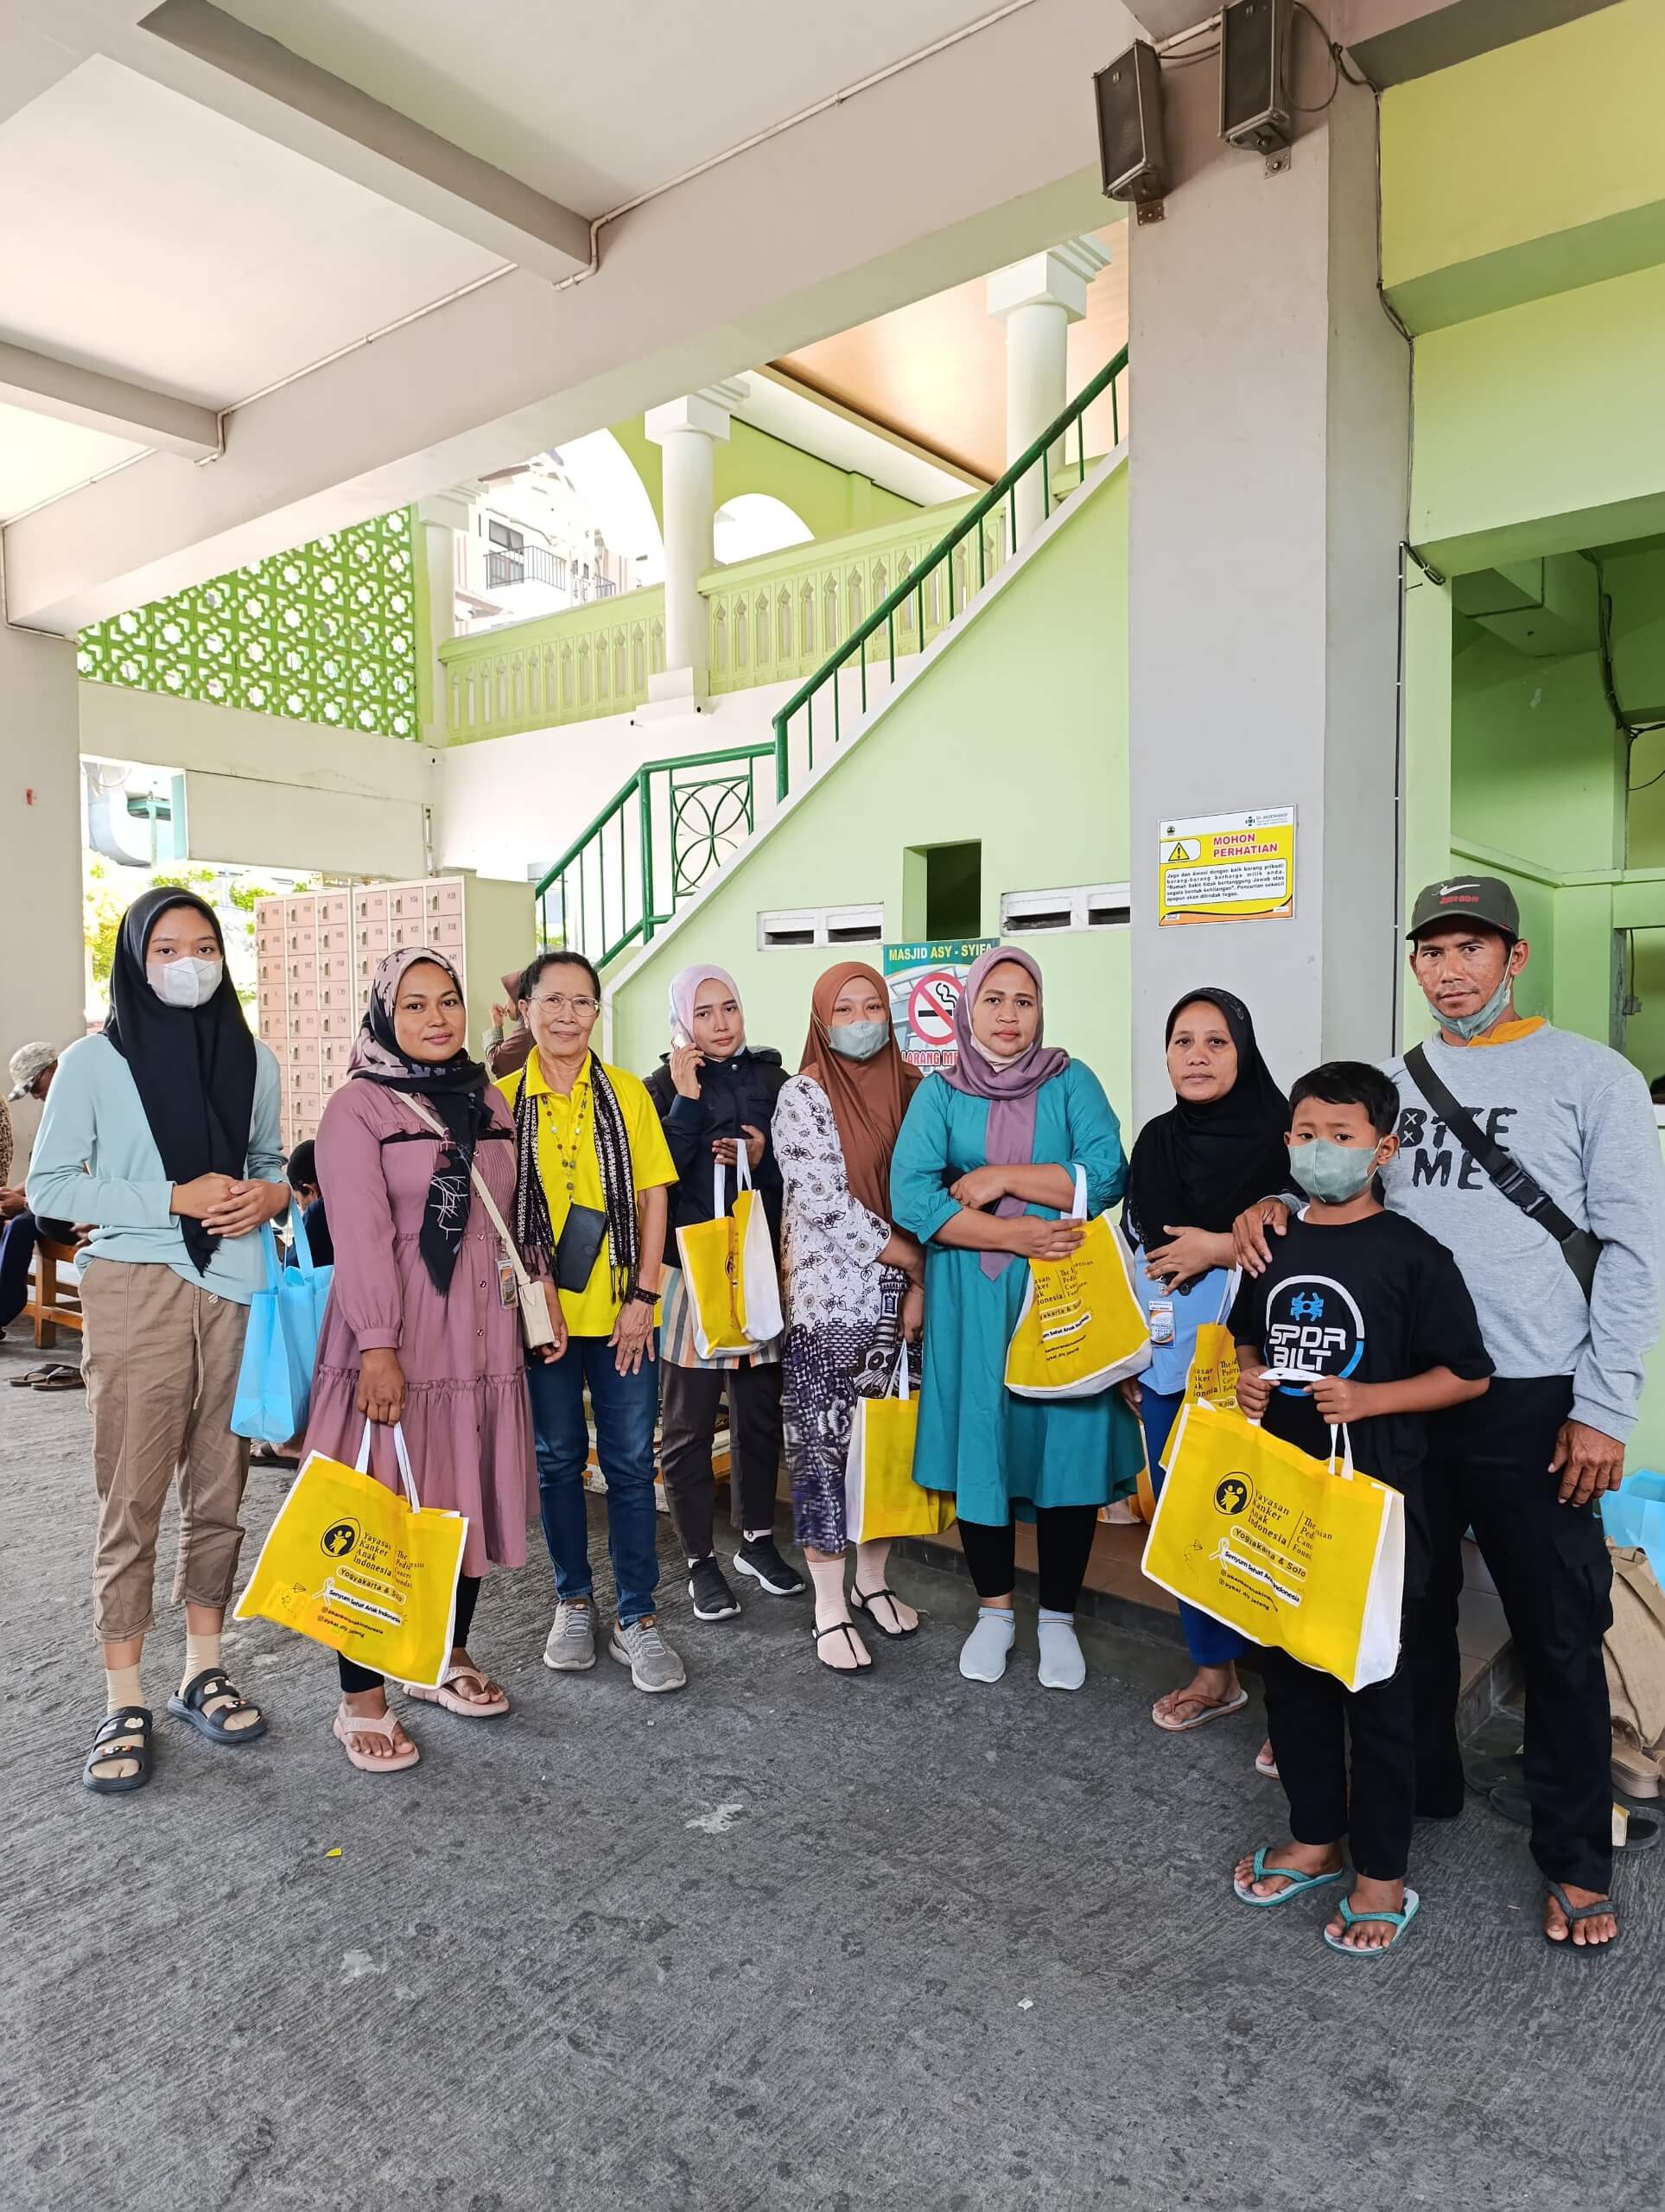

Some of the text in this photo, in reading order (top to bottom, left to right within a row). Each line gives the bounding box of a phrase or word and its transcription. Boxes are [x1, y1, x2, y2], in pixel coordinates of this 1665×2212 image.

[1213, 834, 1255, 845] MOHON
[1213, 843, 1277, 857] PERHATIAN
[889, 947, 928, 961] MASJID
[930, 945, 951, 958] ASY
[1412, 1147, 1484, 1191] ME
[1253, 1497, 1282, 1521] Kanker
[1255, 1490, 1289, 1516] Yayasan
[1250, 1508, 1268, 1524] Anak
[1248, 1515, 1287, 1545] Indonesia
[357, 1548, 376, 1560] Anak
[359, 1540, 388, 1556] Kanker
[353, 1555, 392, 1577] Indonesia
[1225, 1551, 1248, 1567] Senyum
[1287, 1562, 1306, 1577] Solo
[340, 1568, 382, 1590] Yogyakarta
[328, 1590, 350, 1602] Senyum
